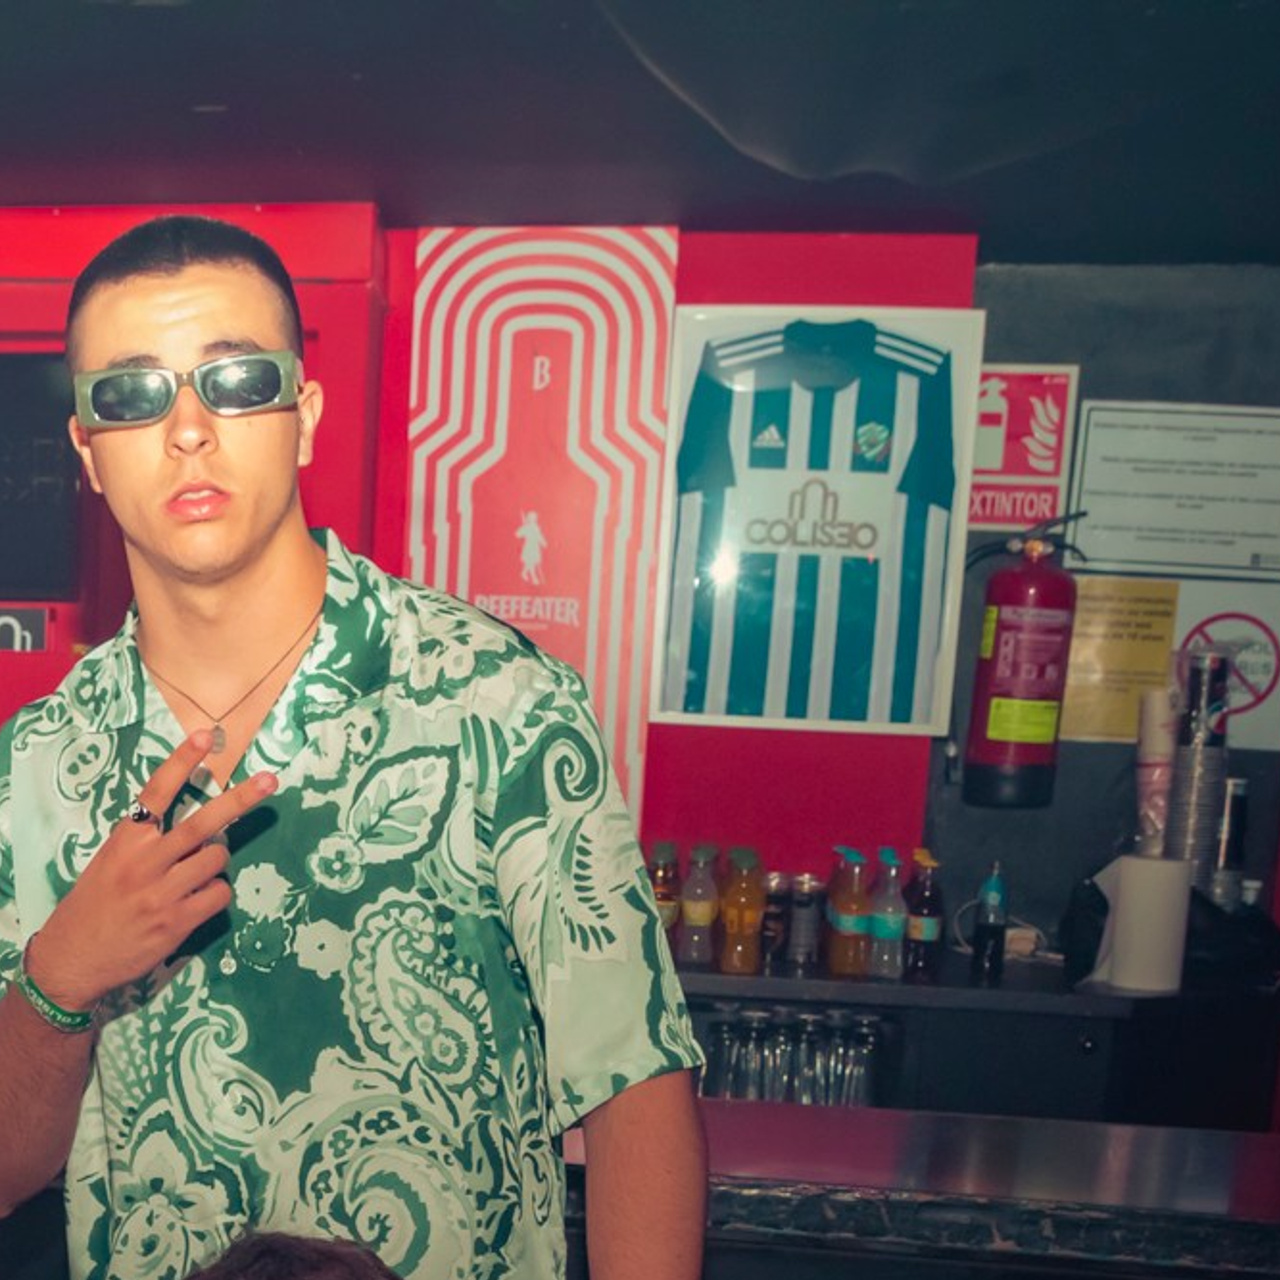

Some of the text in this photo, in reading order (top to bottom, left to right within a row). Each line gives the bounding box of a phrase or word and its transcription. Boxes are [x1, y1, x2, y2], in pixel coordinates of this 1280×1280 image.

[532, 355, 552, 391] B
[970, 490, 1051, 518] XTINTOR
[746, 519, 879, 551] COLISEO
